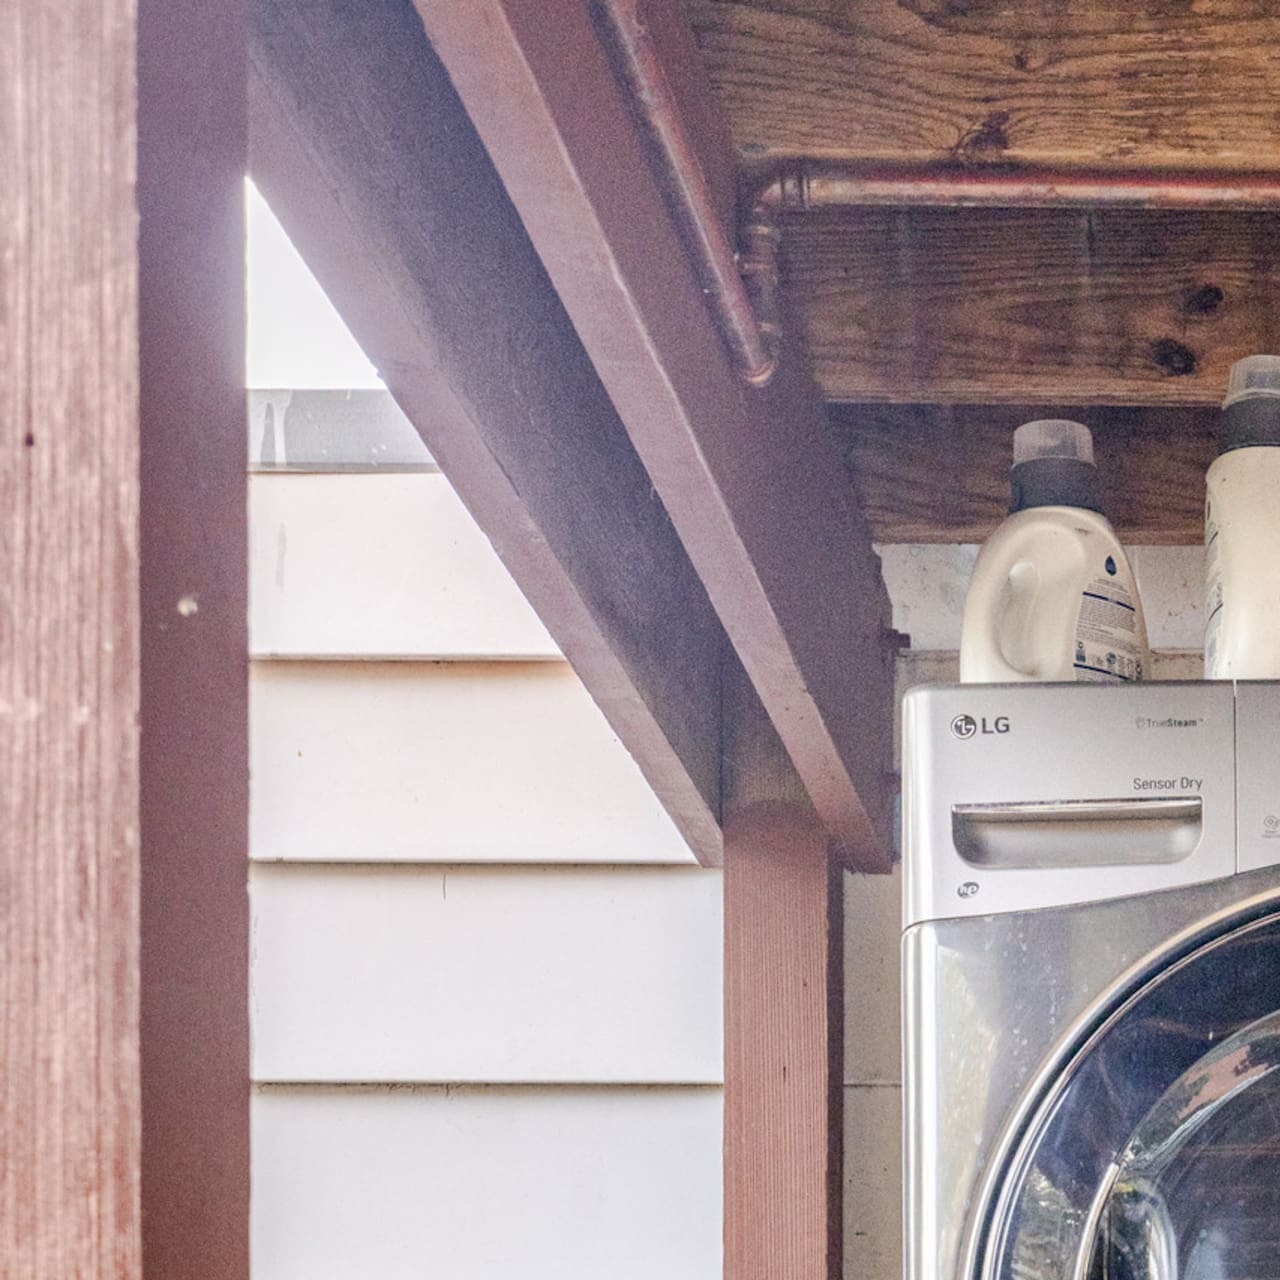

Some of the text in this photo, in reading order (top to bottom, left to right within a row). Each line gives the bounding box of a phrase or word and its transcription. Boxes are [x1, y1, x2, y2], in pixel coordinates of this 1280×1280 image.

[982, 716, 1010, 734] LG
[1133, 776, 1203, 791] Sensor Dry
